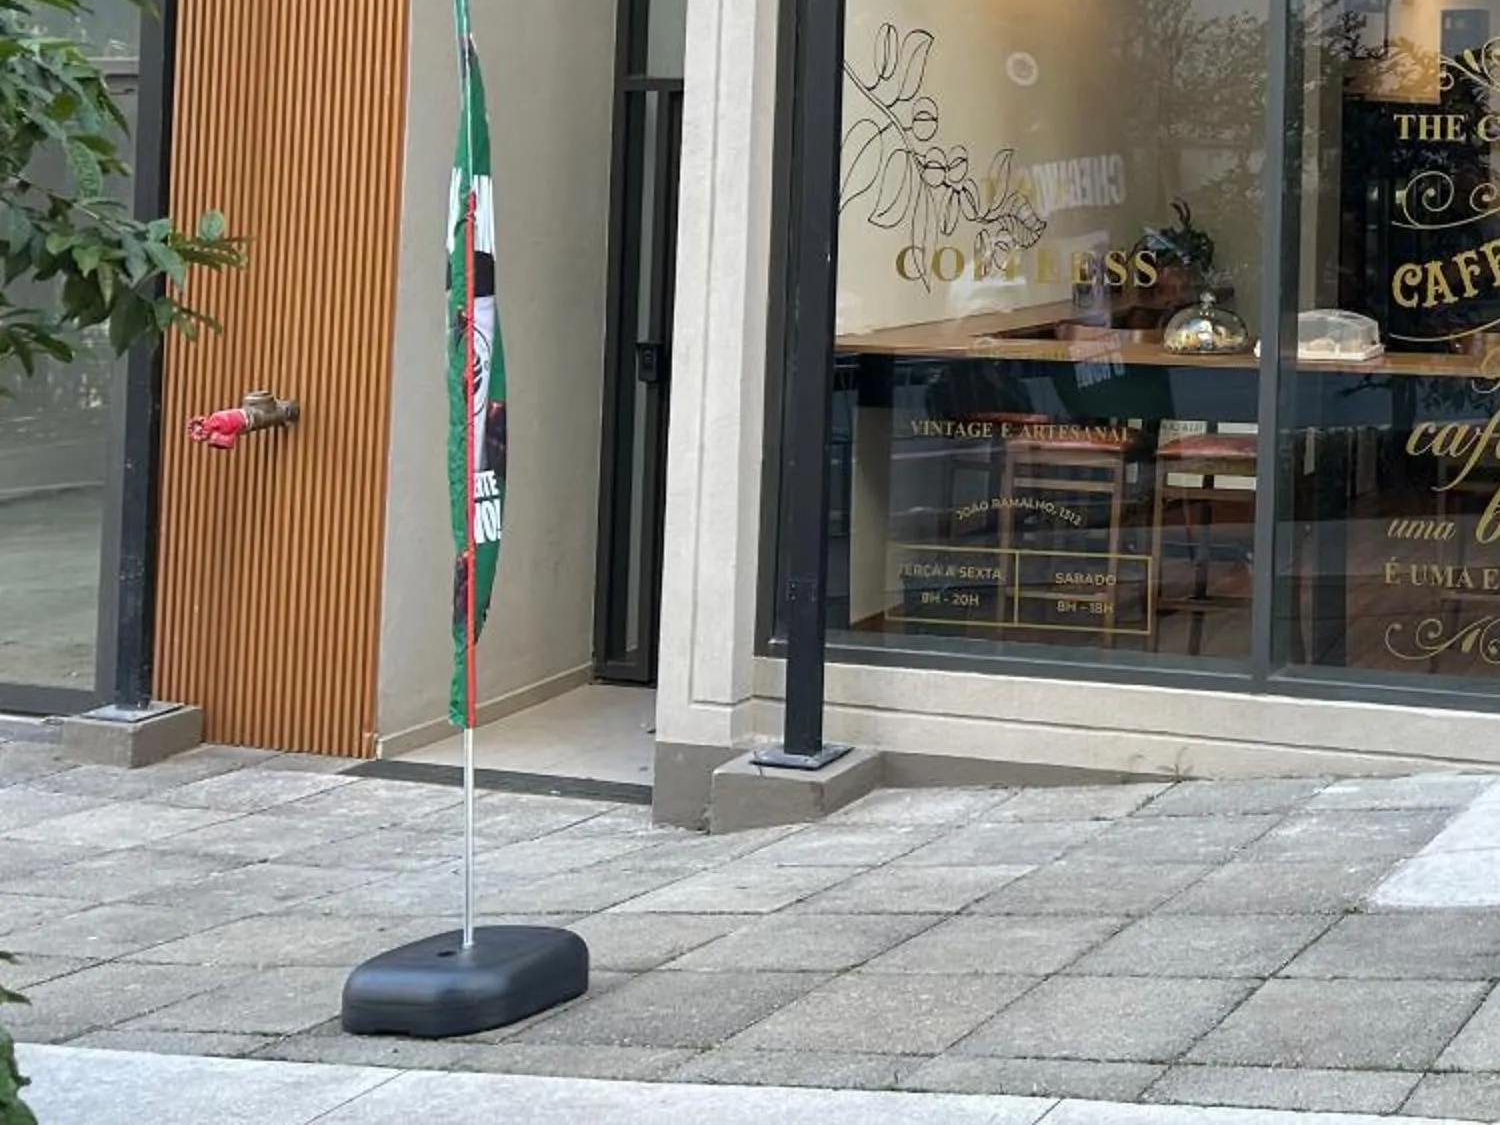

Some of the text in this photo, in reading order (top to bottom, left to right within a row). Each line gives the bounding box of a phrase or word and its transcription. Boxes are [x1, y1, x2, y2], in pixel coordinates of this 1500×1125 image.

[1394, 113, 1466, 143] THE
[911, 419, 993, 439] VINTAGE
[1387, 516, 1457, 542] uma
[1384, 556, 1400, 585] É
[1410, 563, 1475, 590] UMA
